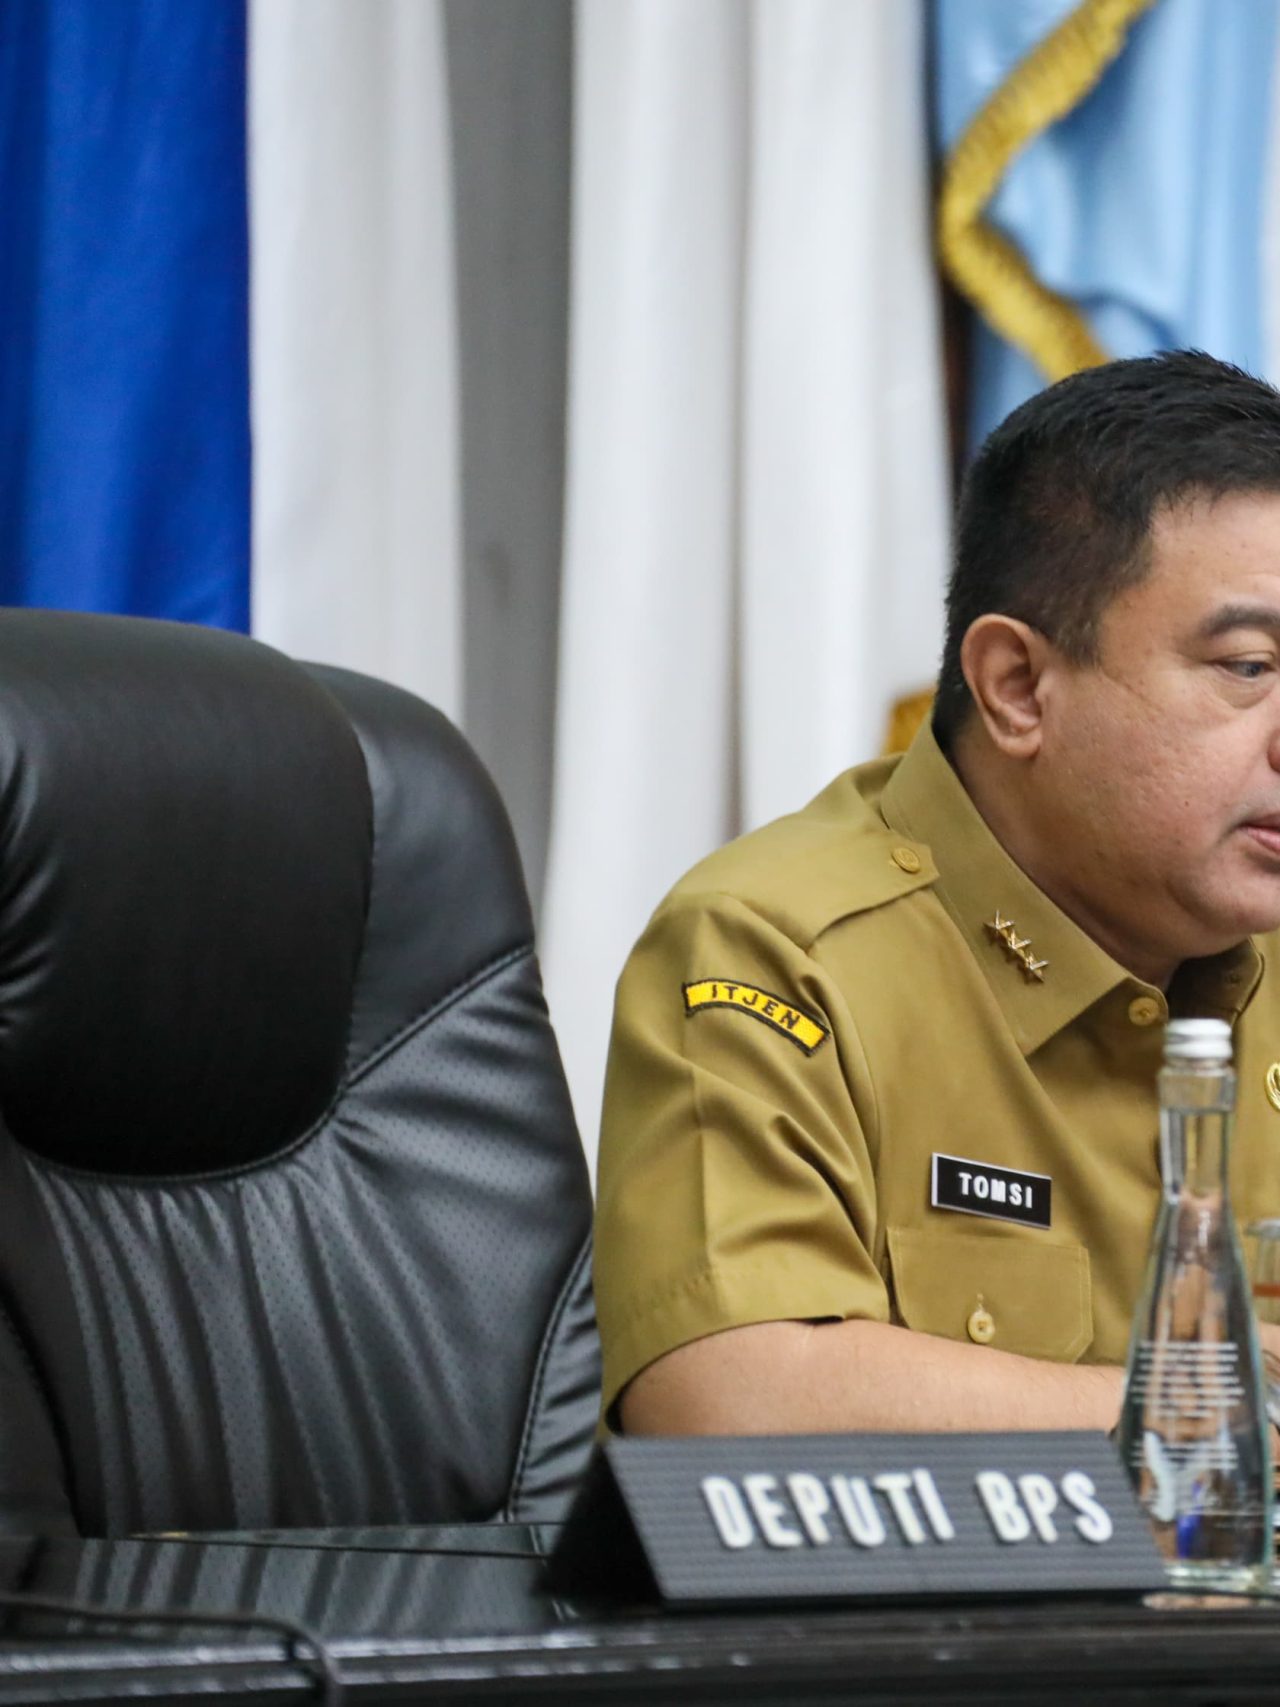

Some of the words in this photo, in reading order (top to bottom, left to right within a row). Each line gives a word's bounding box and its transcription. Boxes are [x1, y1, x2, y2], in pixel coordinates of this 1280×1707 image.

[711, 984, 801, 1030] ITJEN
[958, 1172, 1033, 1209] TOMSI
[702, 1468, 955, 1549] DEPUTI
[975, 1470, 1114, 1544] BPS
